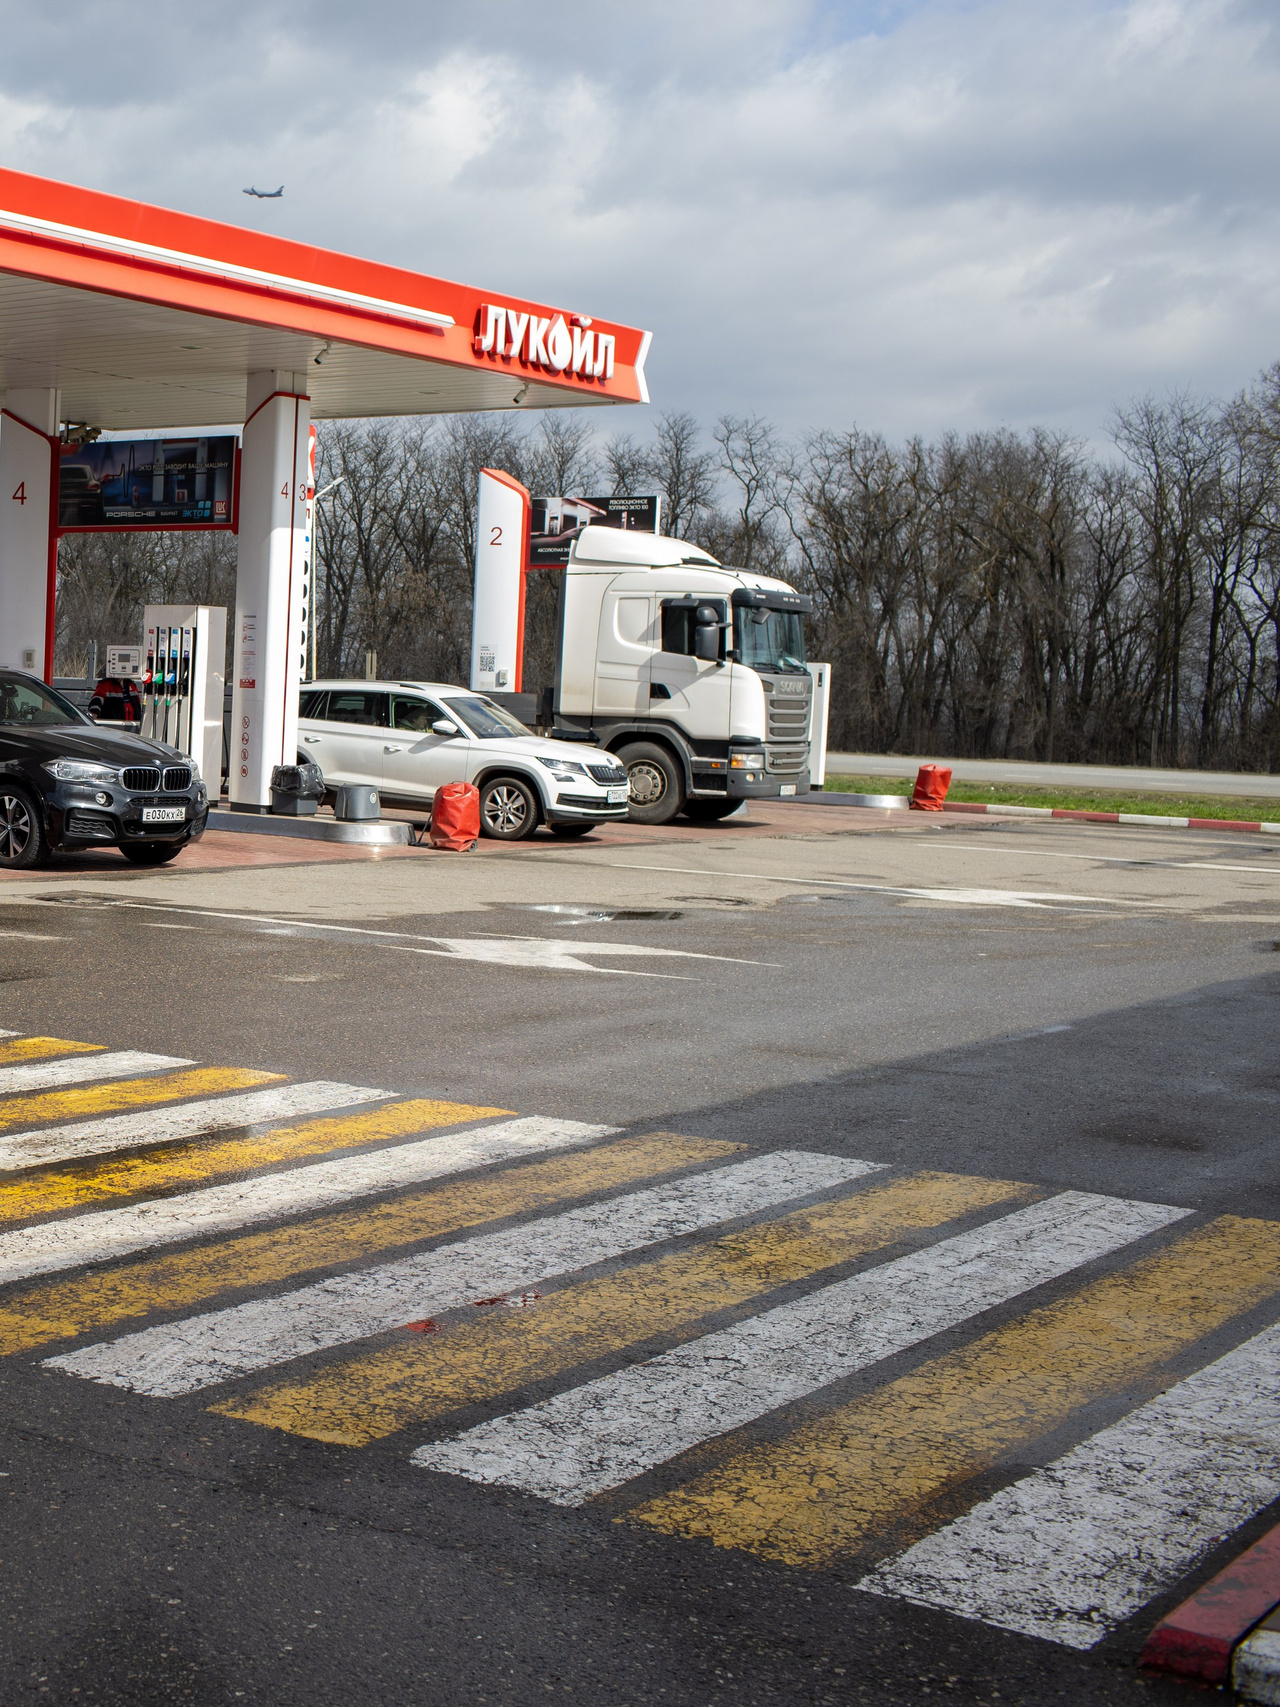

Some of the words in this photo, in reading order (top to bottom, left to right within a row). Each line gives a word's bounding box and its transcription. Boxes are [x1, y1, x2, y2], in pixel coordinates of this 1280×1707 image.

[475, 304, 616, 379] ЛУКОЙЛ
[12, 481, 27, 505] 4
[280, 481, 289, 499] 4
[298, 483, 306, 502] 3
[182, 509, 203, 517] ЭКТО
[490, 526, 503, 546] 2
[780, 680, 804, 693] SCANIA
